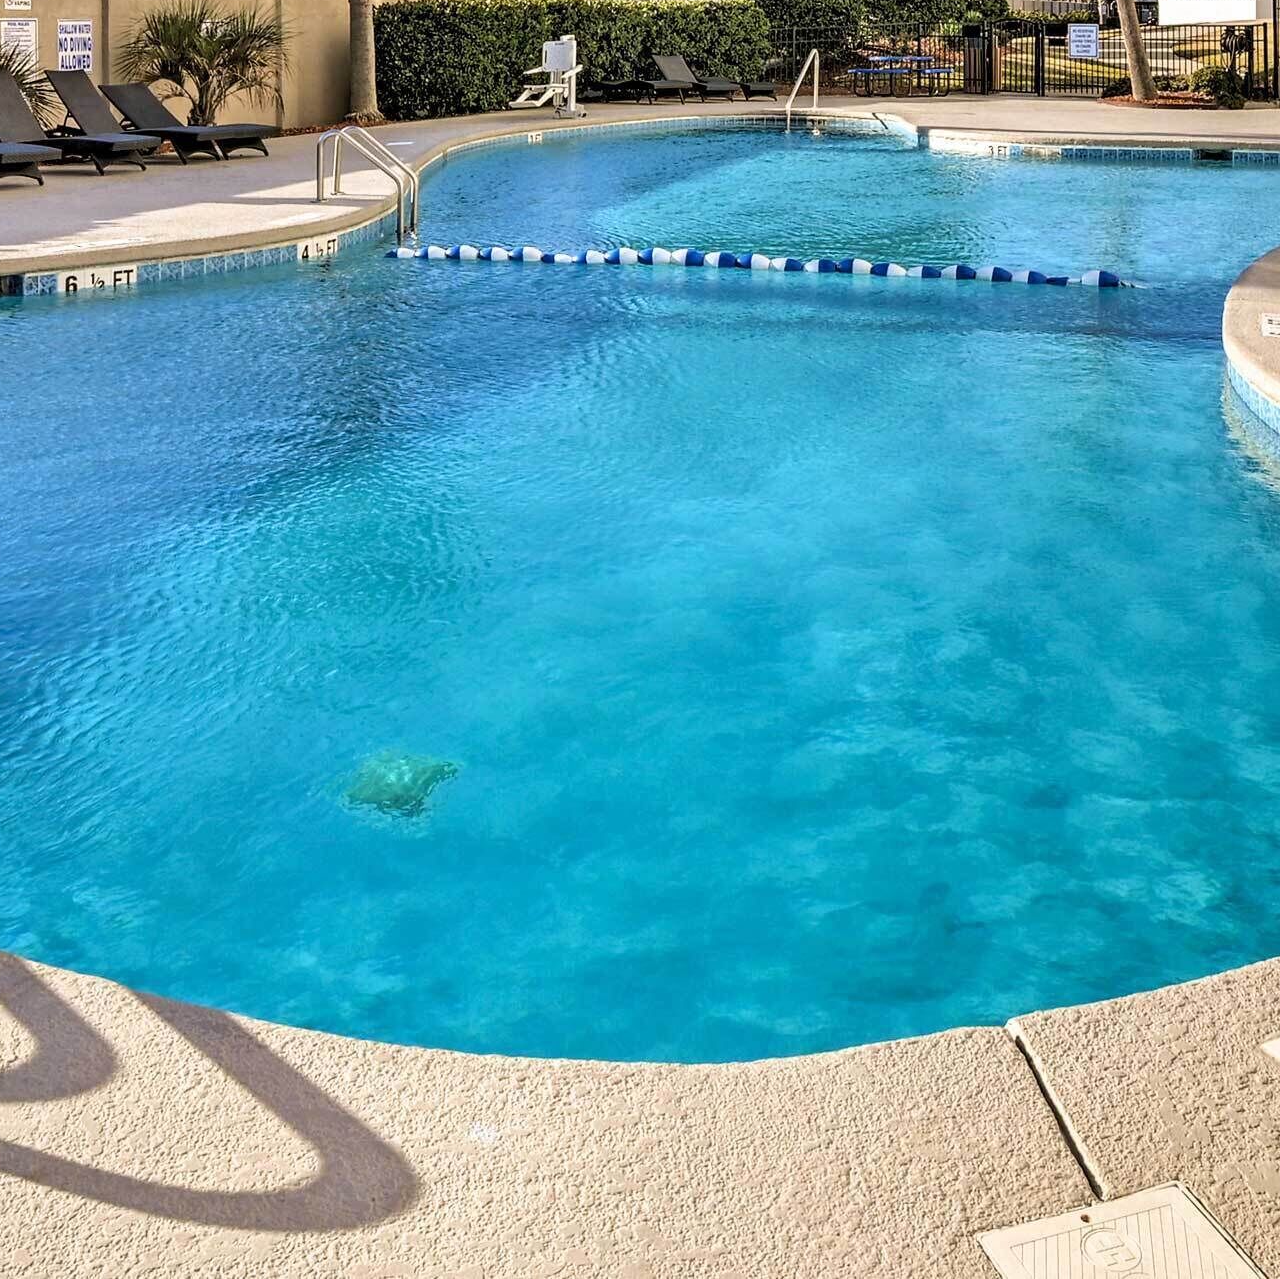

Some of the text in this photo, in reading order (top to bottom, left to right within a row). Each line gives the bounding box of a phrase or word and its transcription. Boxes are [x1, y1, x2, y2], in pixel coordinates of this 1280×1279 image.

[59, 24, 77, 34] SHALLOW
[58, 37, 91, 52] NO DIVING
[61, 54, 90, 69] ALLOWED
[998, 145, 1008, 156] FT
[302, 244, 309, 259] 4
[327, 238, 337, 256] FT
[65, 275, 78, 292] 6
[113, 269, 134, 288] FT
